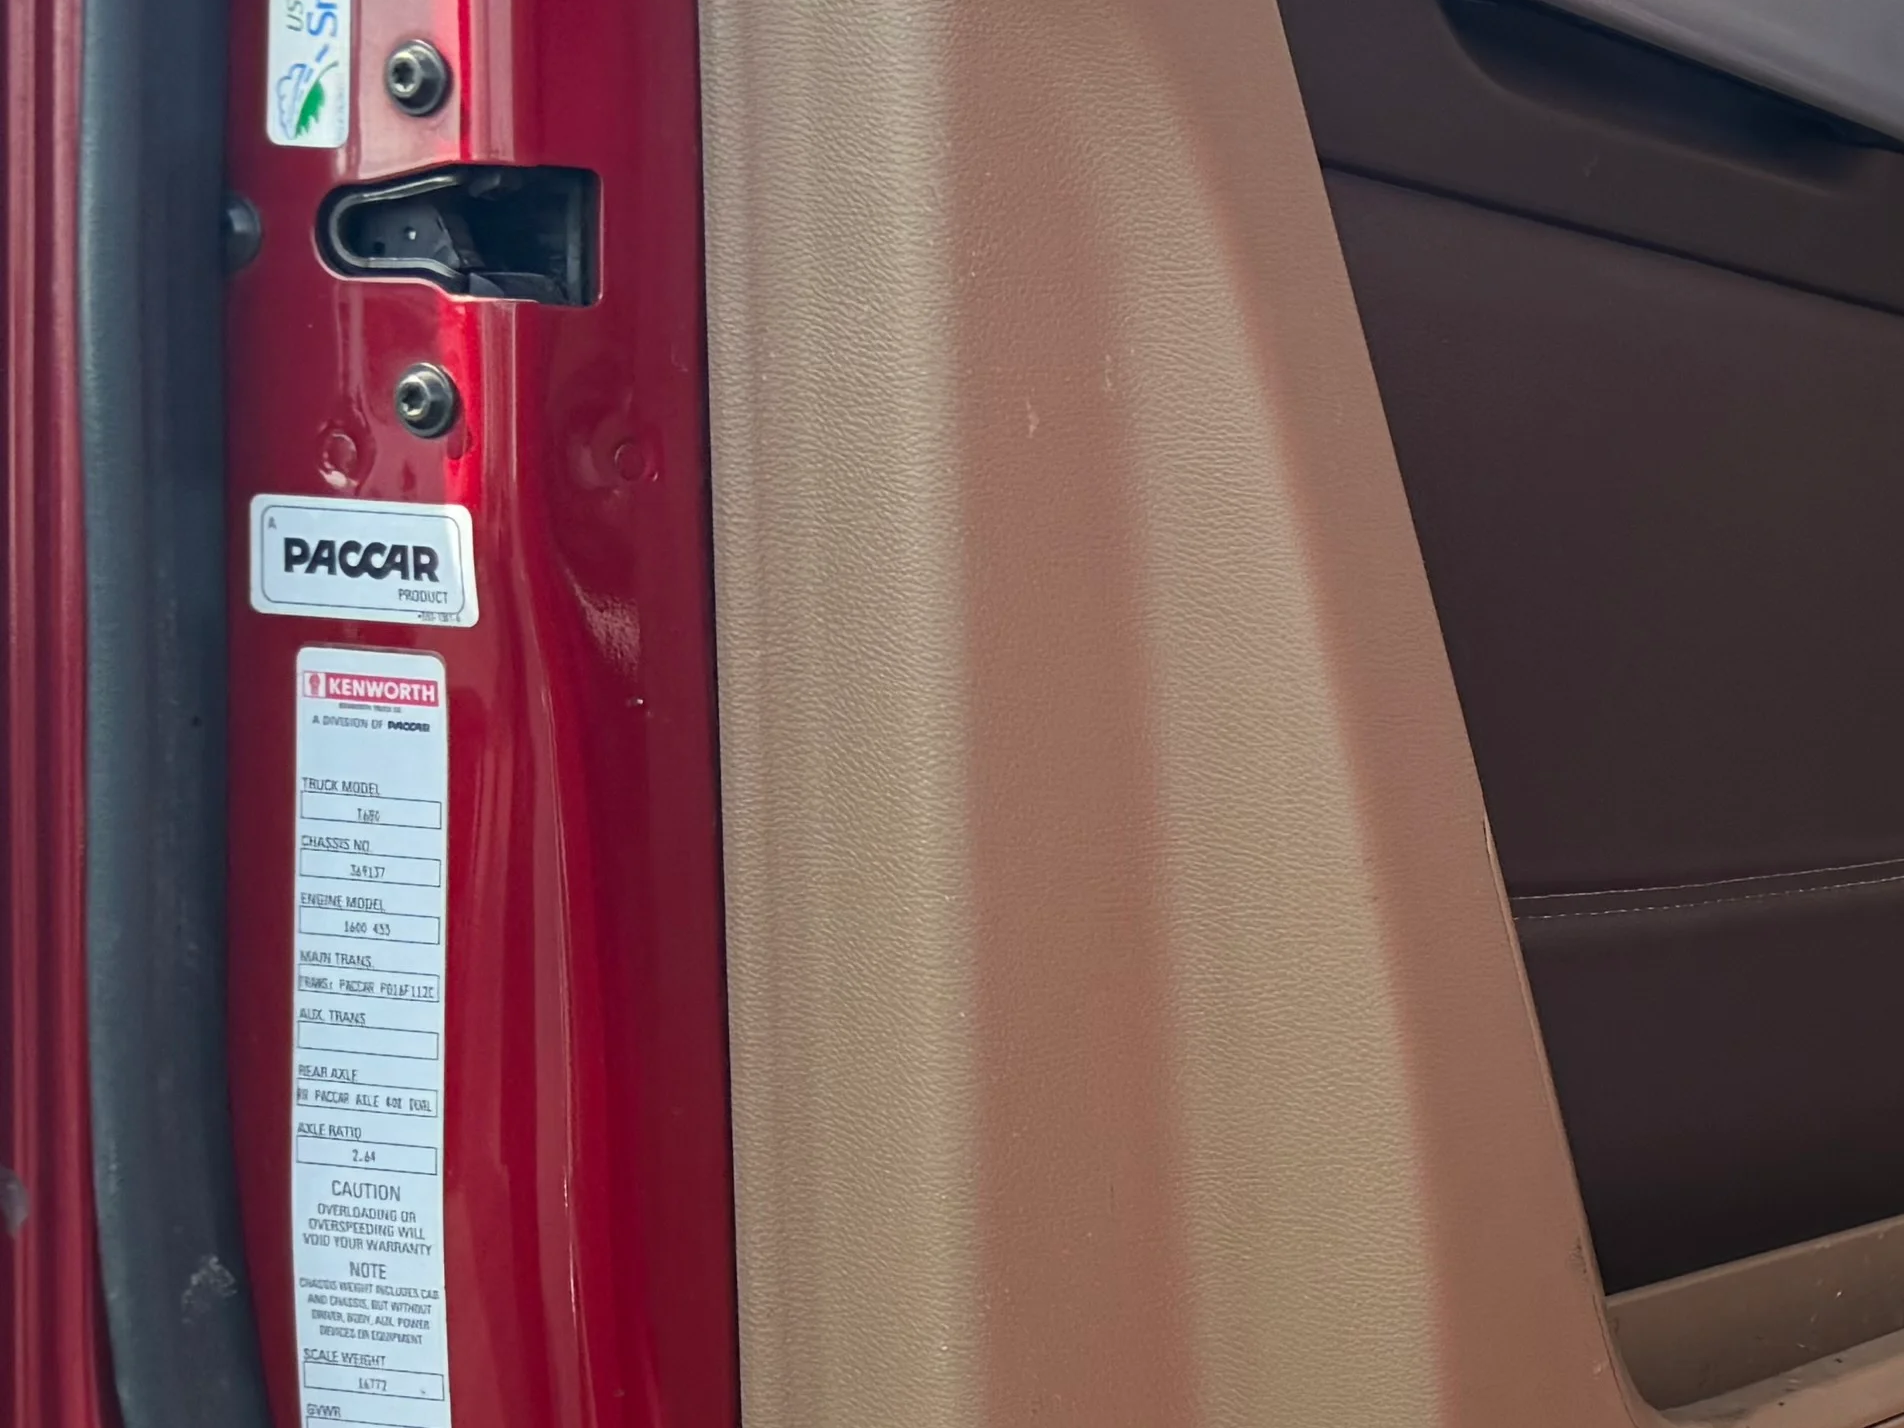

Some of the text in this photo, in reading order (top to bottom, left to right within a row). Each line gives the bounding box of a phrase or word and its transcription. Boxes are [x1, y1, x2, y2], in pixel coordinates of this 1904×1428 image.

[283, 537, 440, 582] PACCAR
[398, 588, 448, 604] PRODUCT
[328, 677, 436, 702] KENWORTH
[301, 776, 380, 795] TRUCK MODEL
[300, 834, 350, 850] CHASSIS
[345, 896, 386, 912] MODEL
[331, 1179, 402, 1203] CAUTION
[317, 1202, 417, 1224] OVERLOADING OR
[308, 1217, 426, 1241] OVERSPEEDING WILL
[302, 1232, 433, 1257] VOID YOUR WARRANTY
[349, 1260, 388, 1280] NOTE
